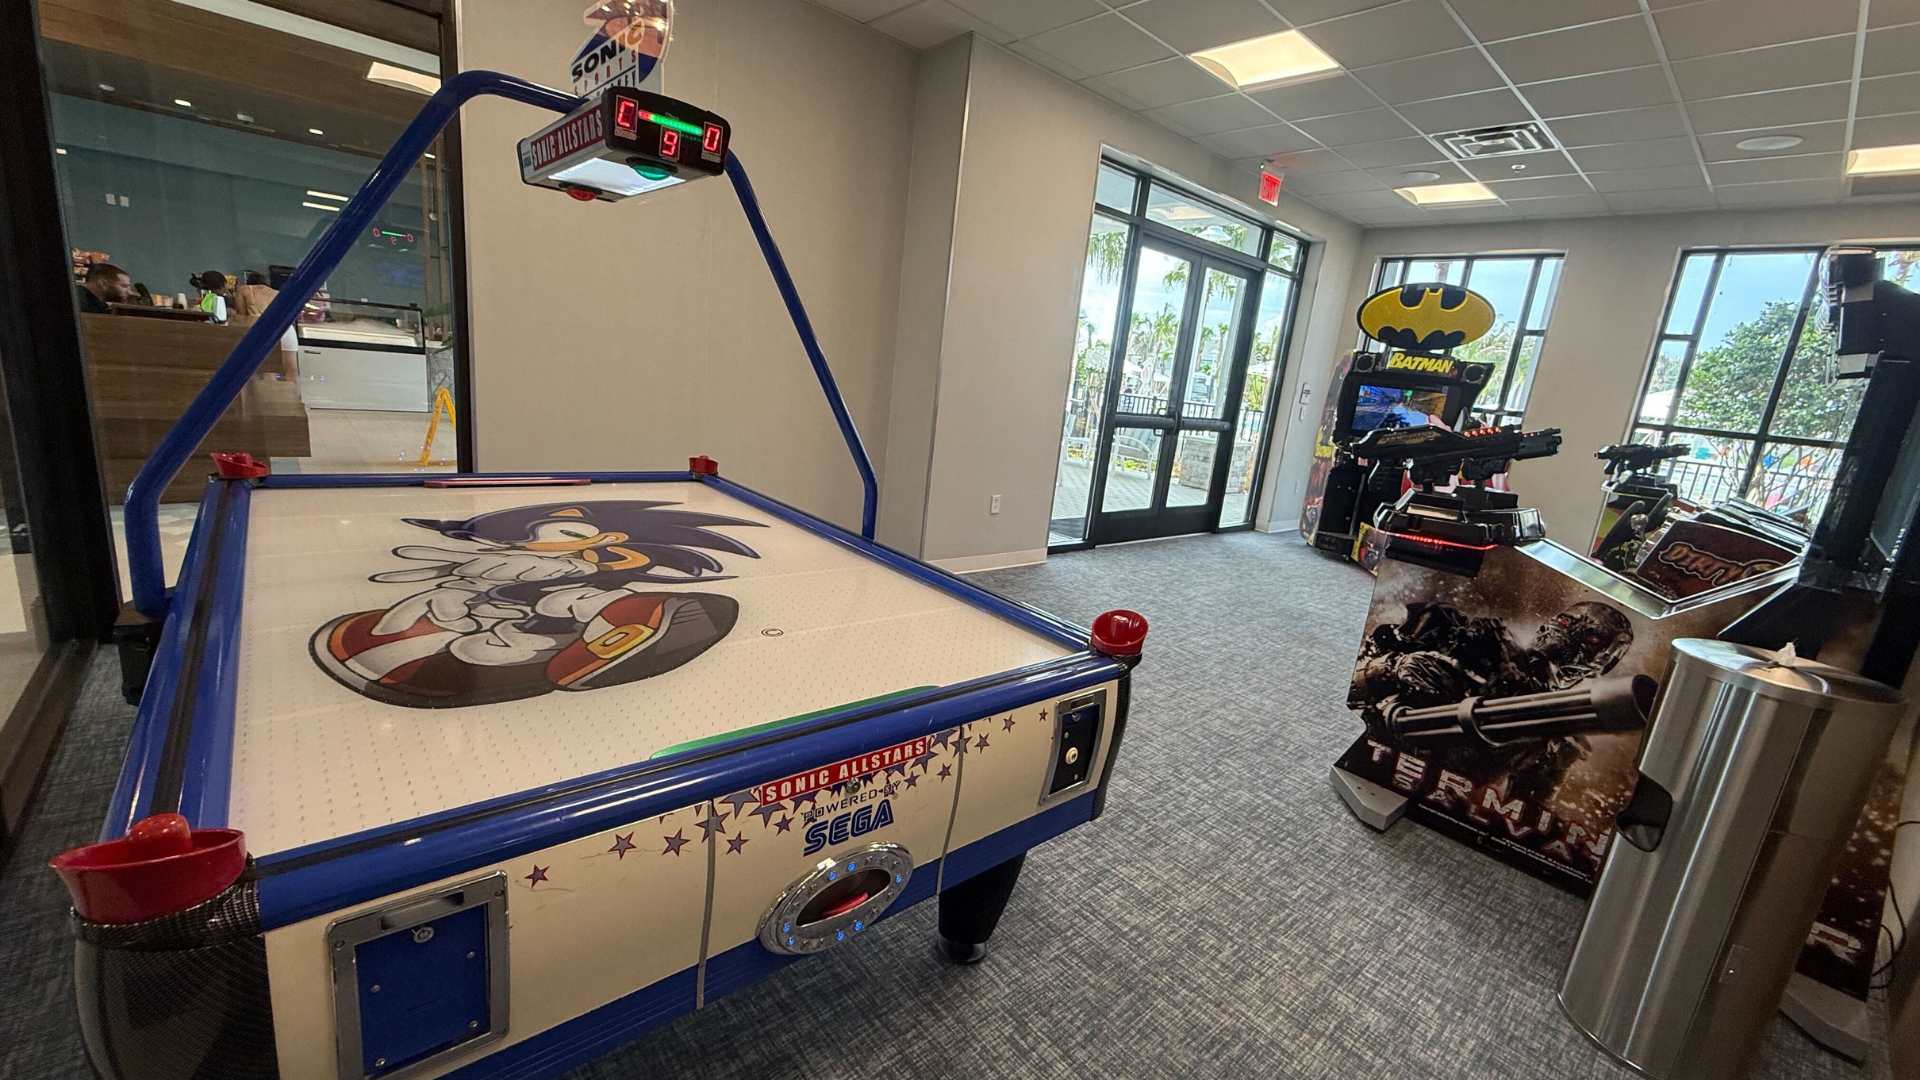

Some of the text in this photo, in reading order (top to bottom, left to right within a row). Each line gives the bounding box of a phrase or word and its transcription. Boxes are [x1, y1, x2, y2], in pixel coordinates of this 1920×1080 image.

[532, 135, 556, 169] SONIC
[662, 131, 678, 155] 9
[1390, 352, 1454, 374] BATMAN
[765, 740, 925, 802] SONIC ALLSTARS
[803, 799, 894, 857] SEGA
